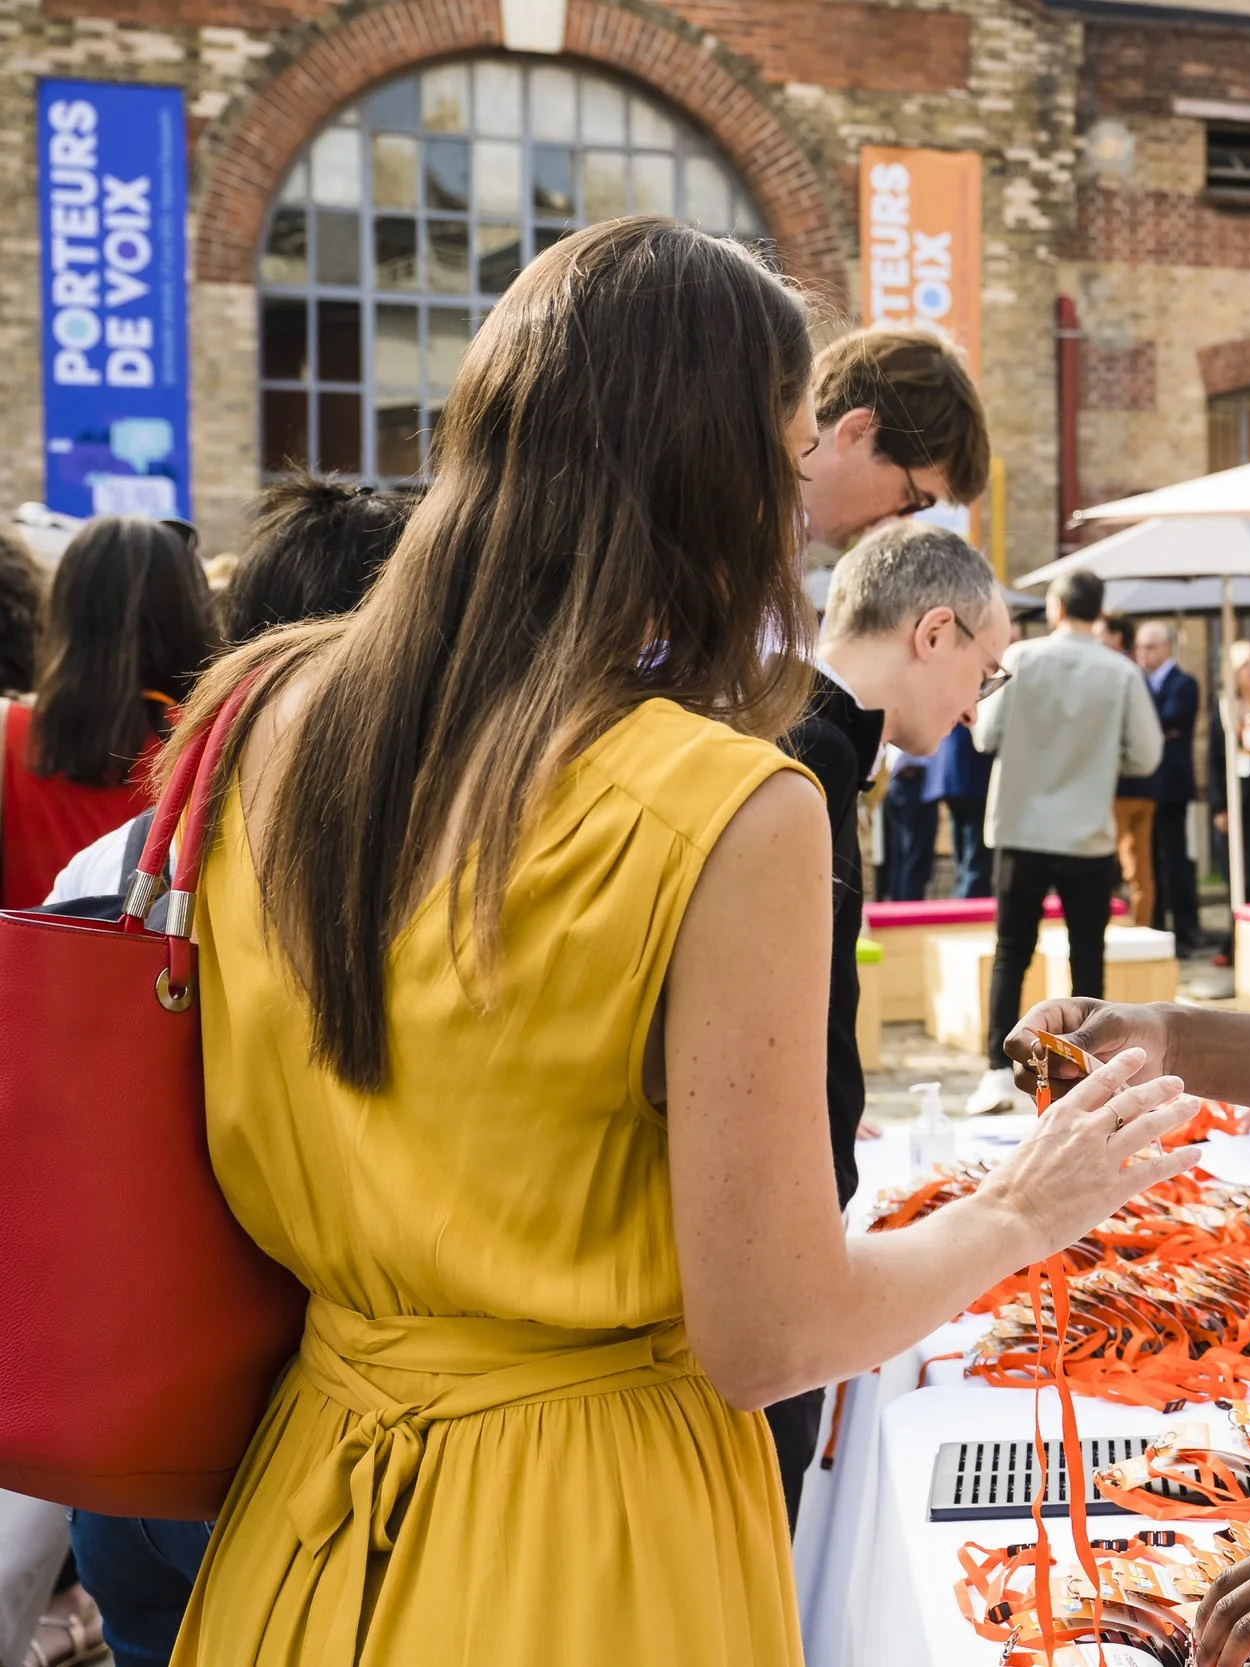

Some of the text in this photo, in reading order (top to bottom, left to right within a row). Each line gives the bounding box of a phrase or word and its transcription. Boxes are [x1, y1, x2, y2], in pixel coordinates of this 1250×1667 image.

[48, 101, 101, 386] PORTEURS
[103, 174, 153, 387] DE VOIX
[869, 163, 911, 328] TEURS
